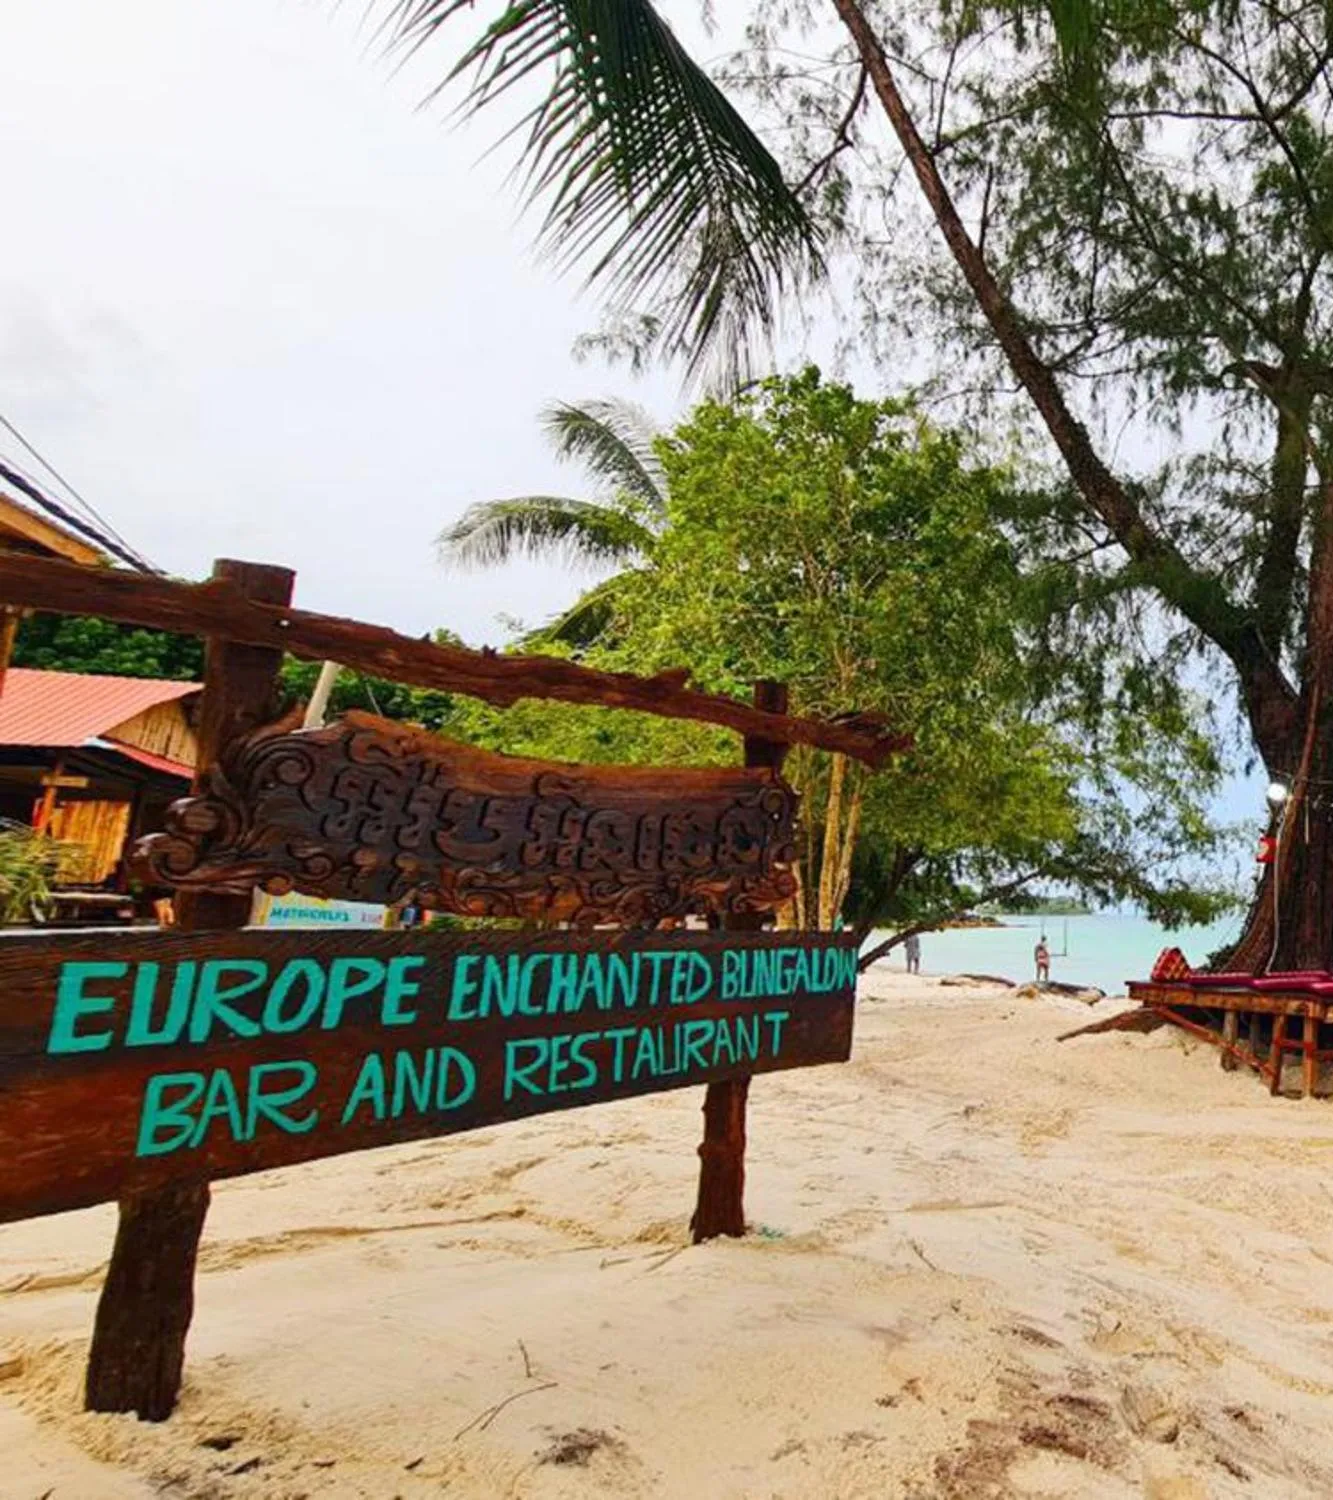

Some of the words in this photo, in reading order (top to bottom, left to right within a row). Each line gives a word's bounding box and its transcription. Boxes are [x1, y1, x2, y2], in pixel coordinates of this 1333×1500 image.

[47, 955, 424, 1053] EUROPE
[447, 950, 711, 1021] ENCHANTED
[721, 947, 859, 998] BUNGALOW
[136, 1060, 317, 1157] BAR
[342, 1047, 477, 1125] AND
[504, 1011, 790, 1100] RESTAURANT
